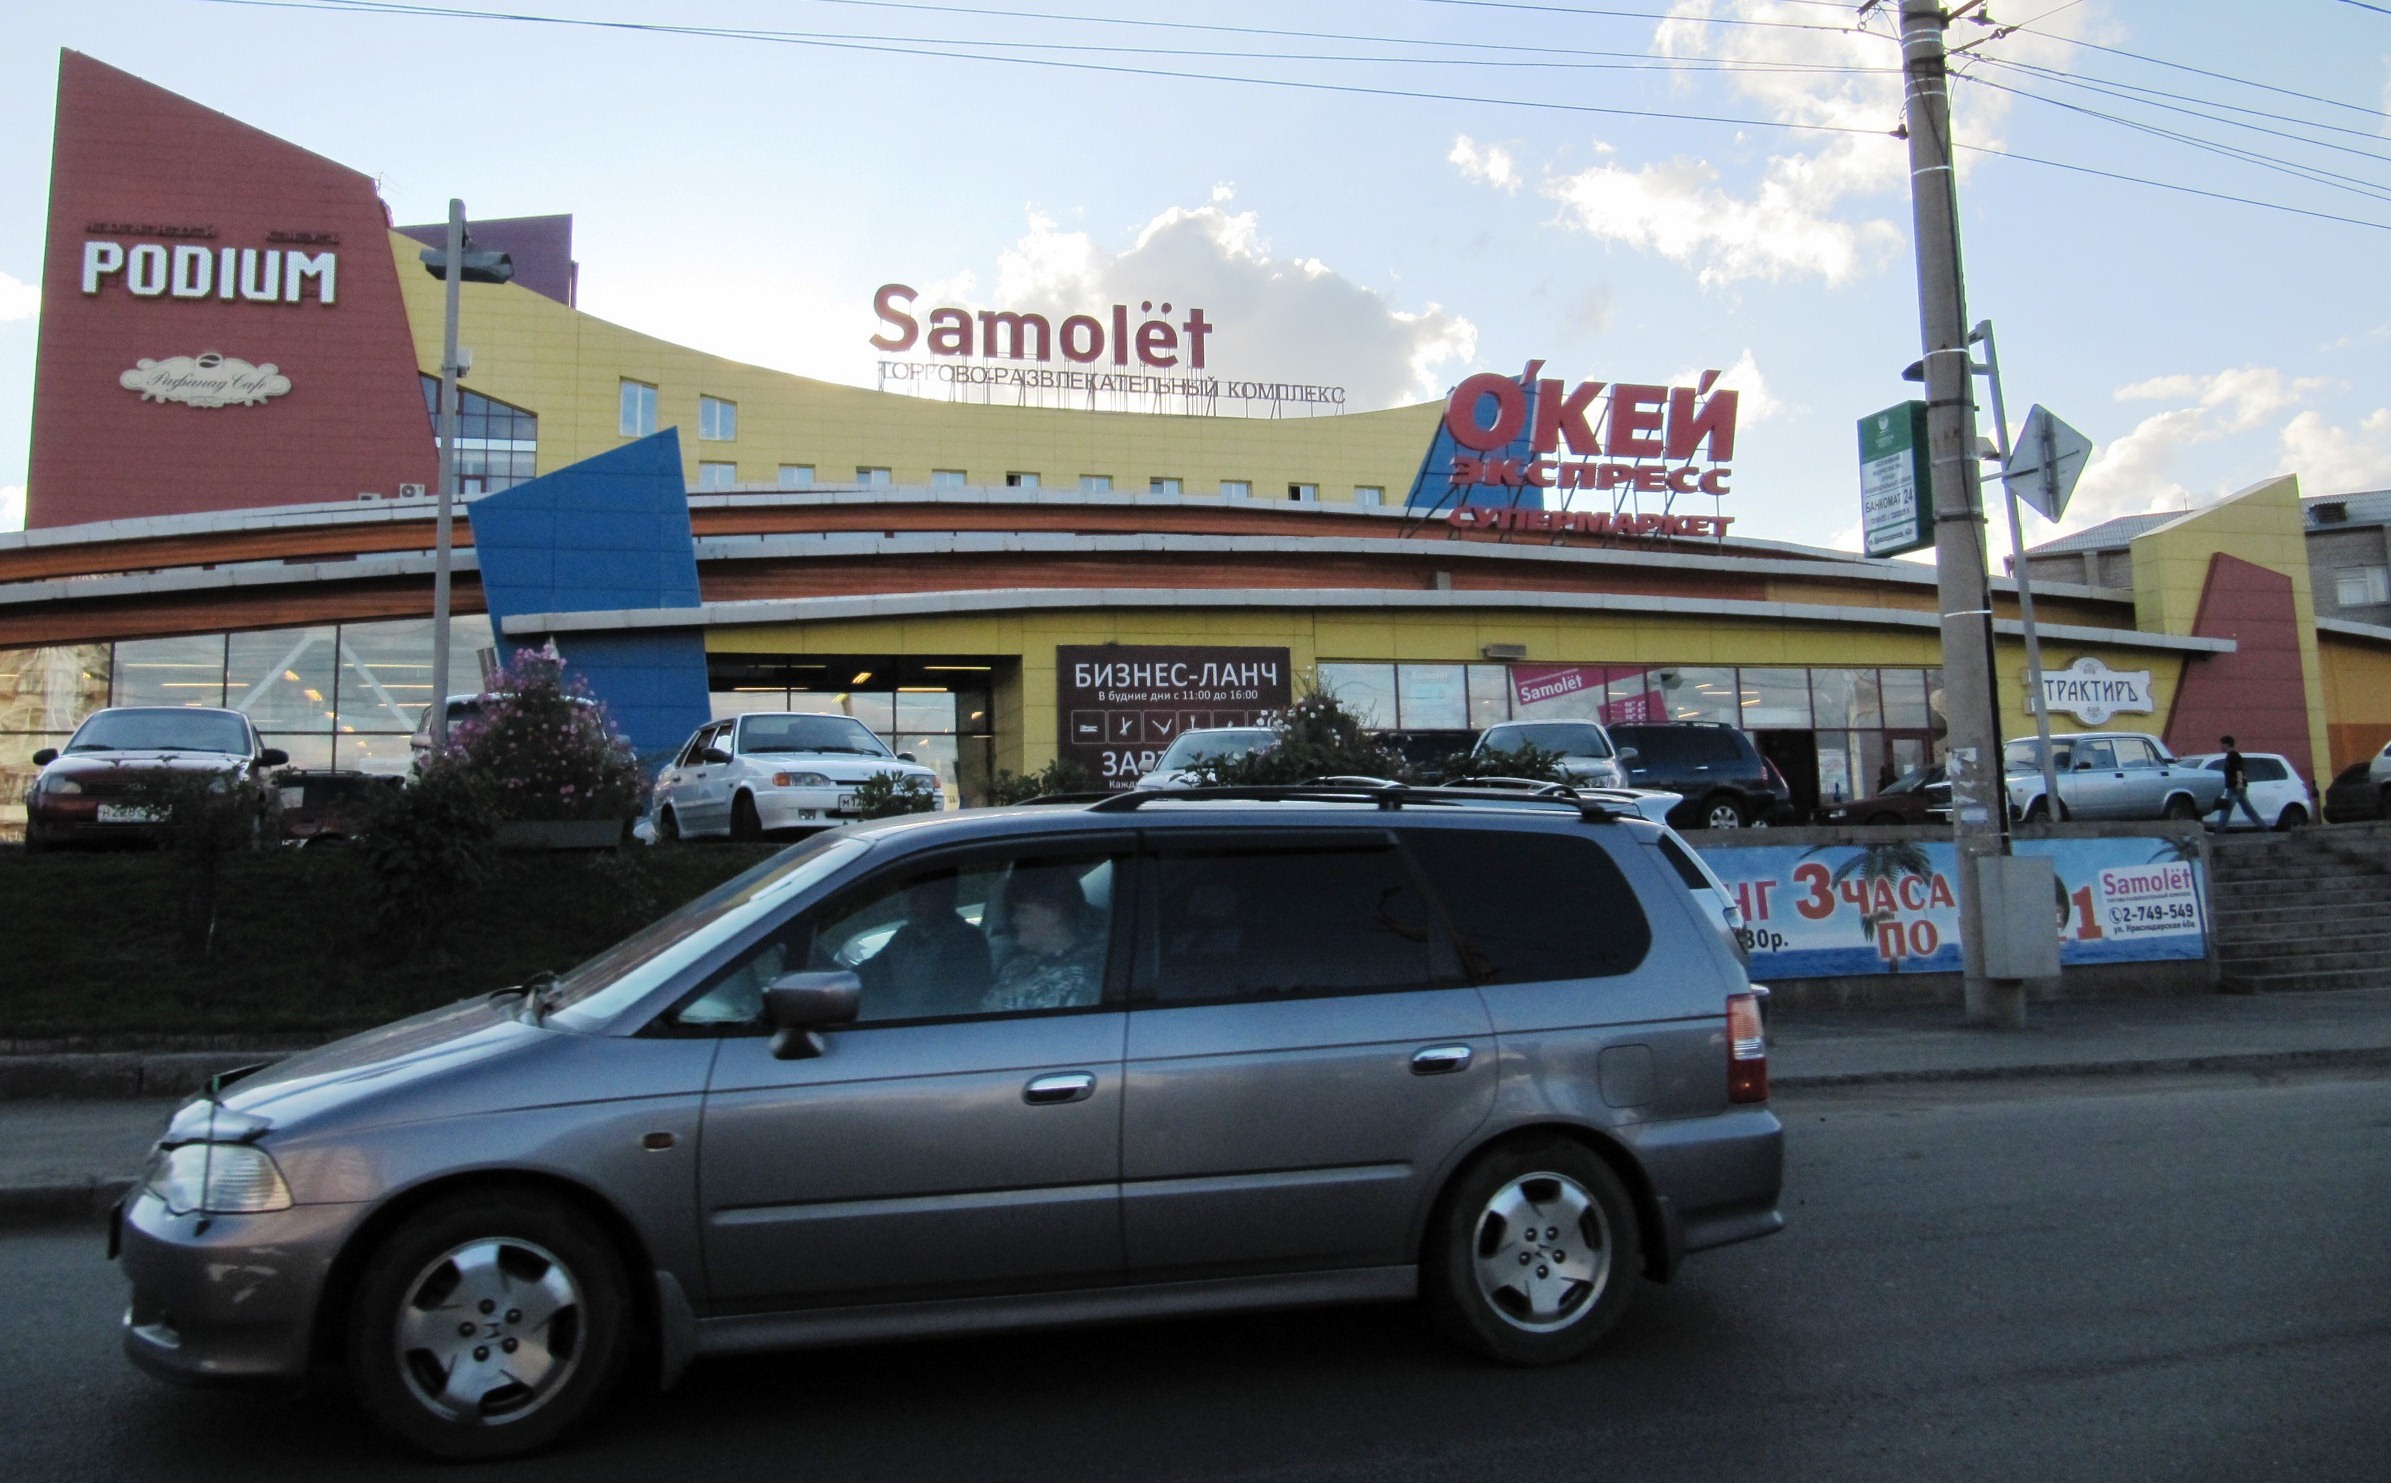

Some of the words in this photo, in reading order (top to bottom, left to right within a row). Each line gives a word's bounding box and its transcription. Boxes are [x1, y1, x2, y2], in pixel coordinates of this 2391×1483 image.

[82, 241, 337, 304] PODIUM
[869, 283, 1212, 369] Samolët
[880, 360, 1218, 397] ТОРГОВО-РАЗВЛЕКАТЕЛЬНЫЙ
[1228, 380, 1346, 404] КОМПЛЕКС
[1450, 456, 1732, 495] ЭКСПРЕСС
[1446, 506, 1735, 538] СУПЕРМАРКЕТ
[1075, 663, 1277, 688] БИЗНЕС-ЛАНЧ
[1521, 674, 1583, 702] Samolët
[2044, 680, 2138, 702] ТРАКТИРЪ
[1098, 691, 1106, 700] В
[1108, 691, 1148, 702] будние
[1150, 692, 1171, 702] дни
[1173, 692, 1179, 700] с
[1182, 690, 1211, 700] 11:00
[1213, 691, 1227, 701] до
[1230, 690, 1258, 699] 16:00
[1793, 863, 1836, 920] 3
[1840, 874, 1956, 916] ЧАСА
[2103, 868, 2191, 896] Samolët
[2123, 903, 2194, 922] 2-749-549
[1877, 920, 1938, 959] ПО
